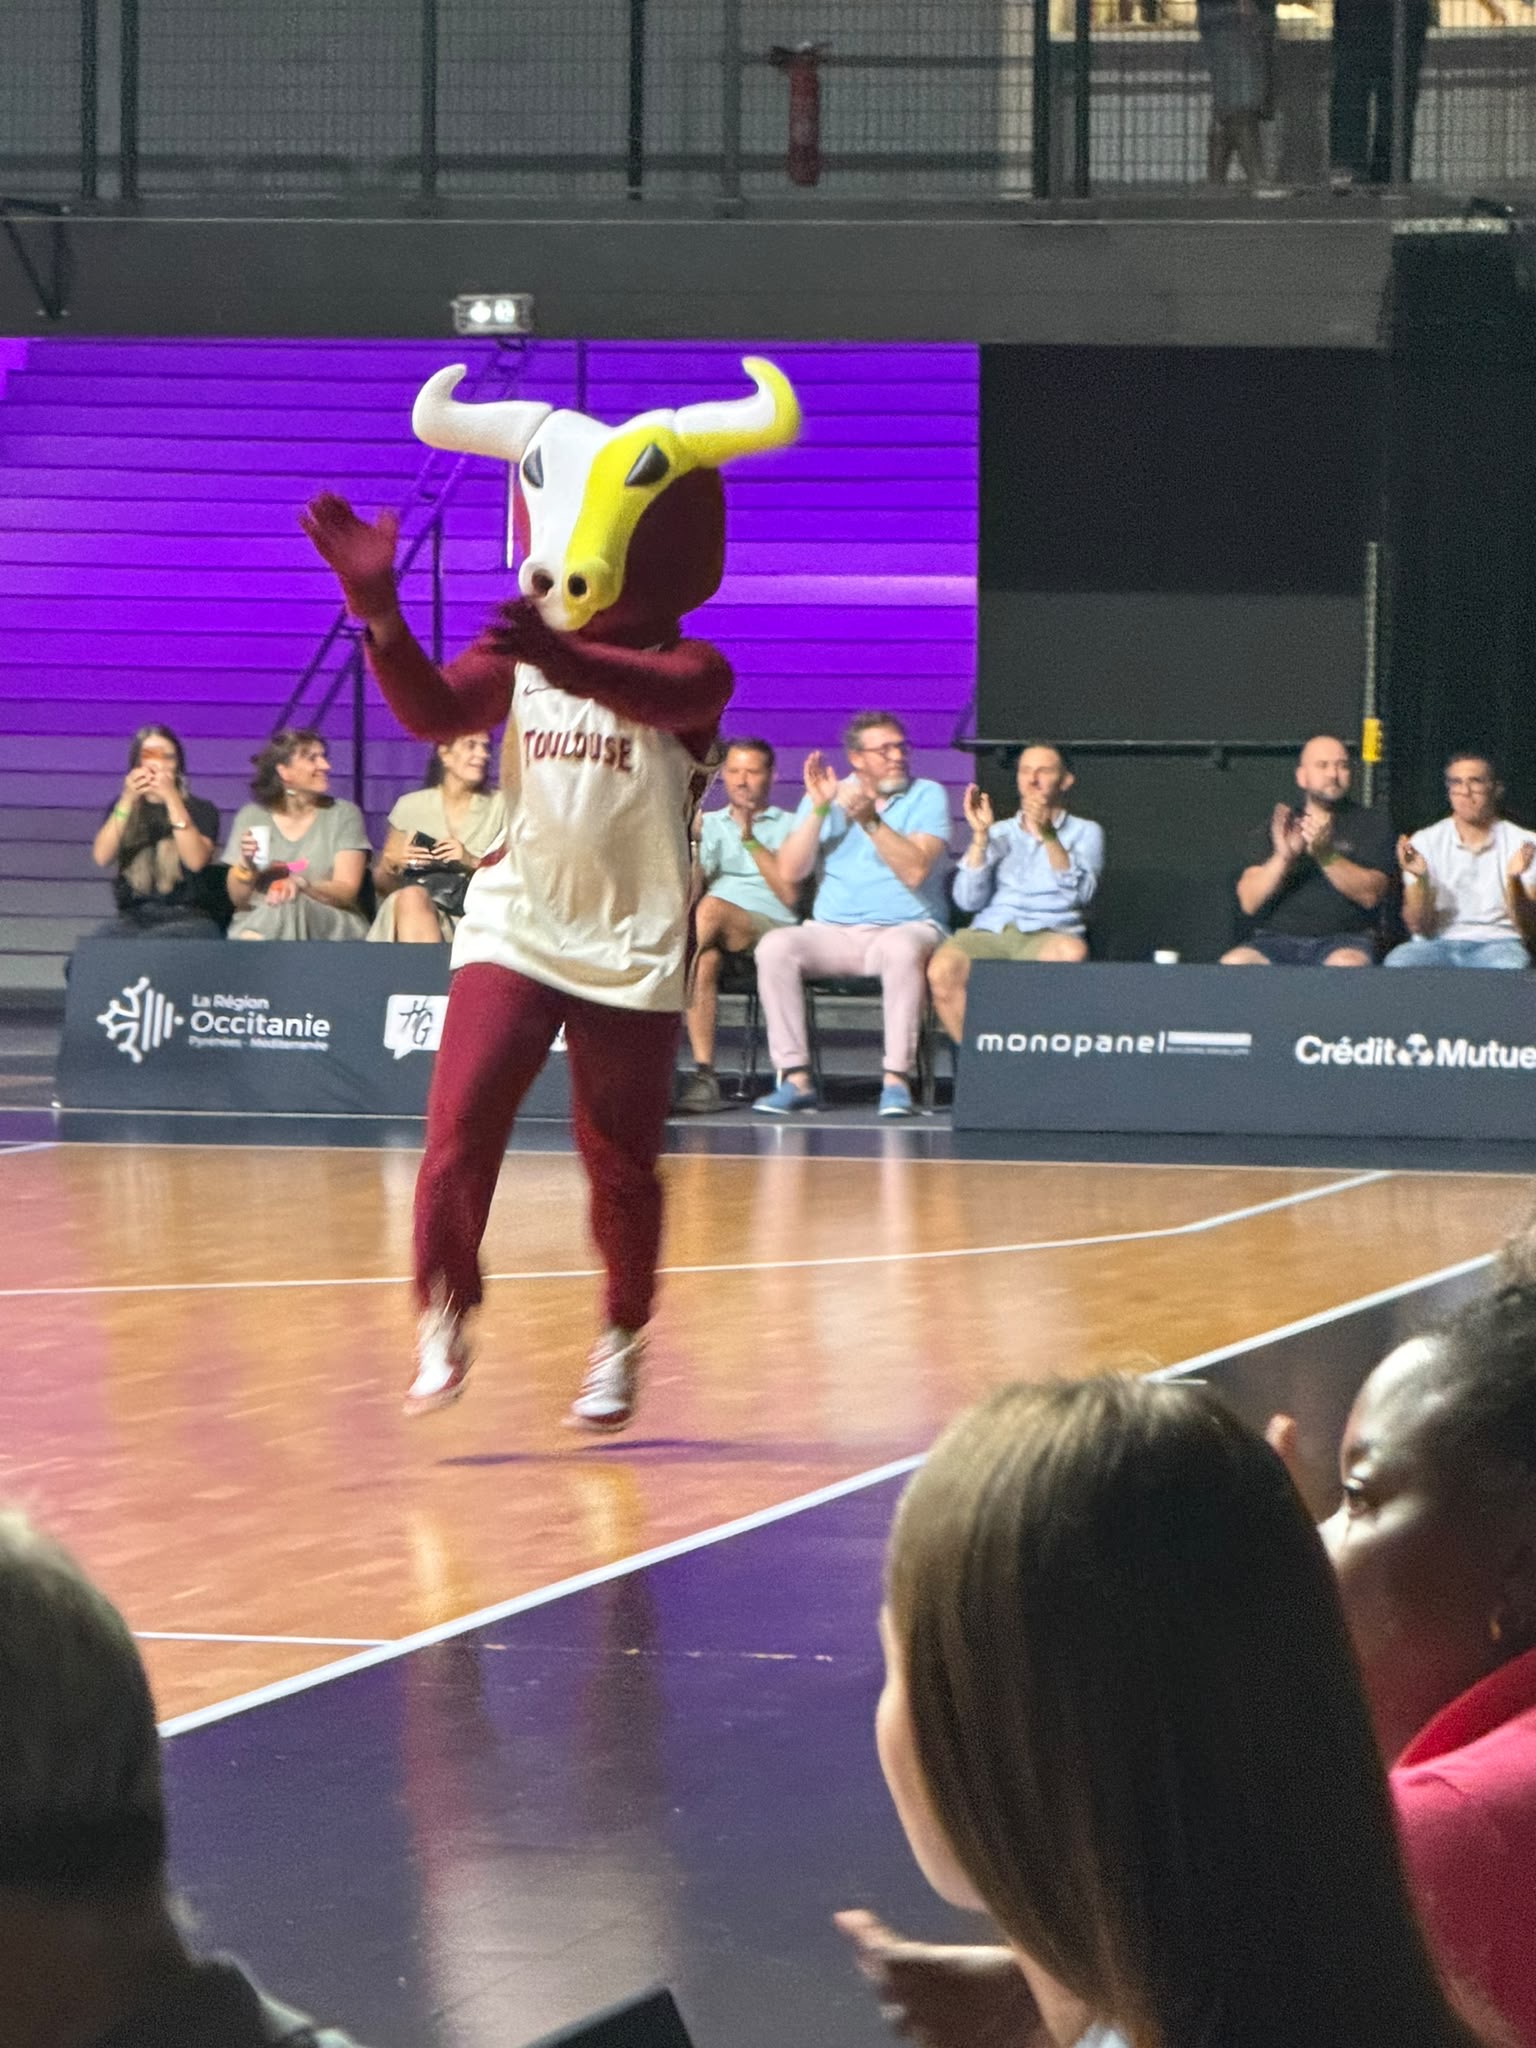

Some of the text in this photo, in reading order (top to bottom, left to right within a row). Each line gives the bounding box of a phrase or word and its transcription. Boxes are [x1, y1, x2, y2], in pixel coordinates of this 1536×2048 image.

[523, 729, 633, 772] TOULOUSE
[191, 993, 211, 1008] La
[190, 1010, 330, 1037] Occitanie
[976, 1031, 1166, 1058] monopanel
[1295, 1034, 1536, 1069] Crédit Mutue
